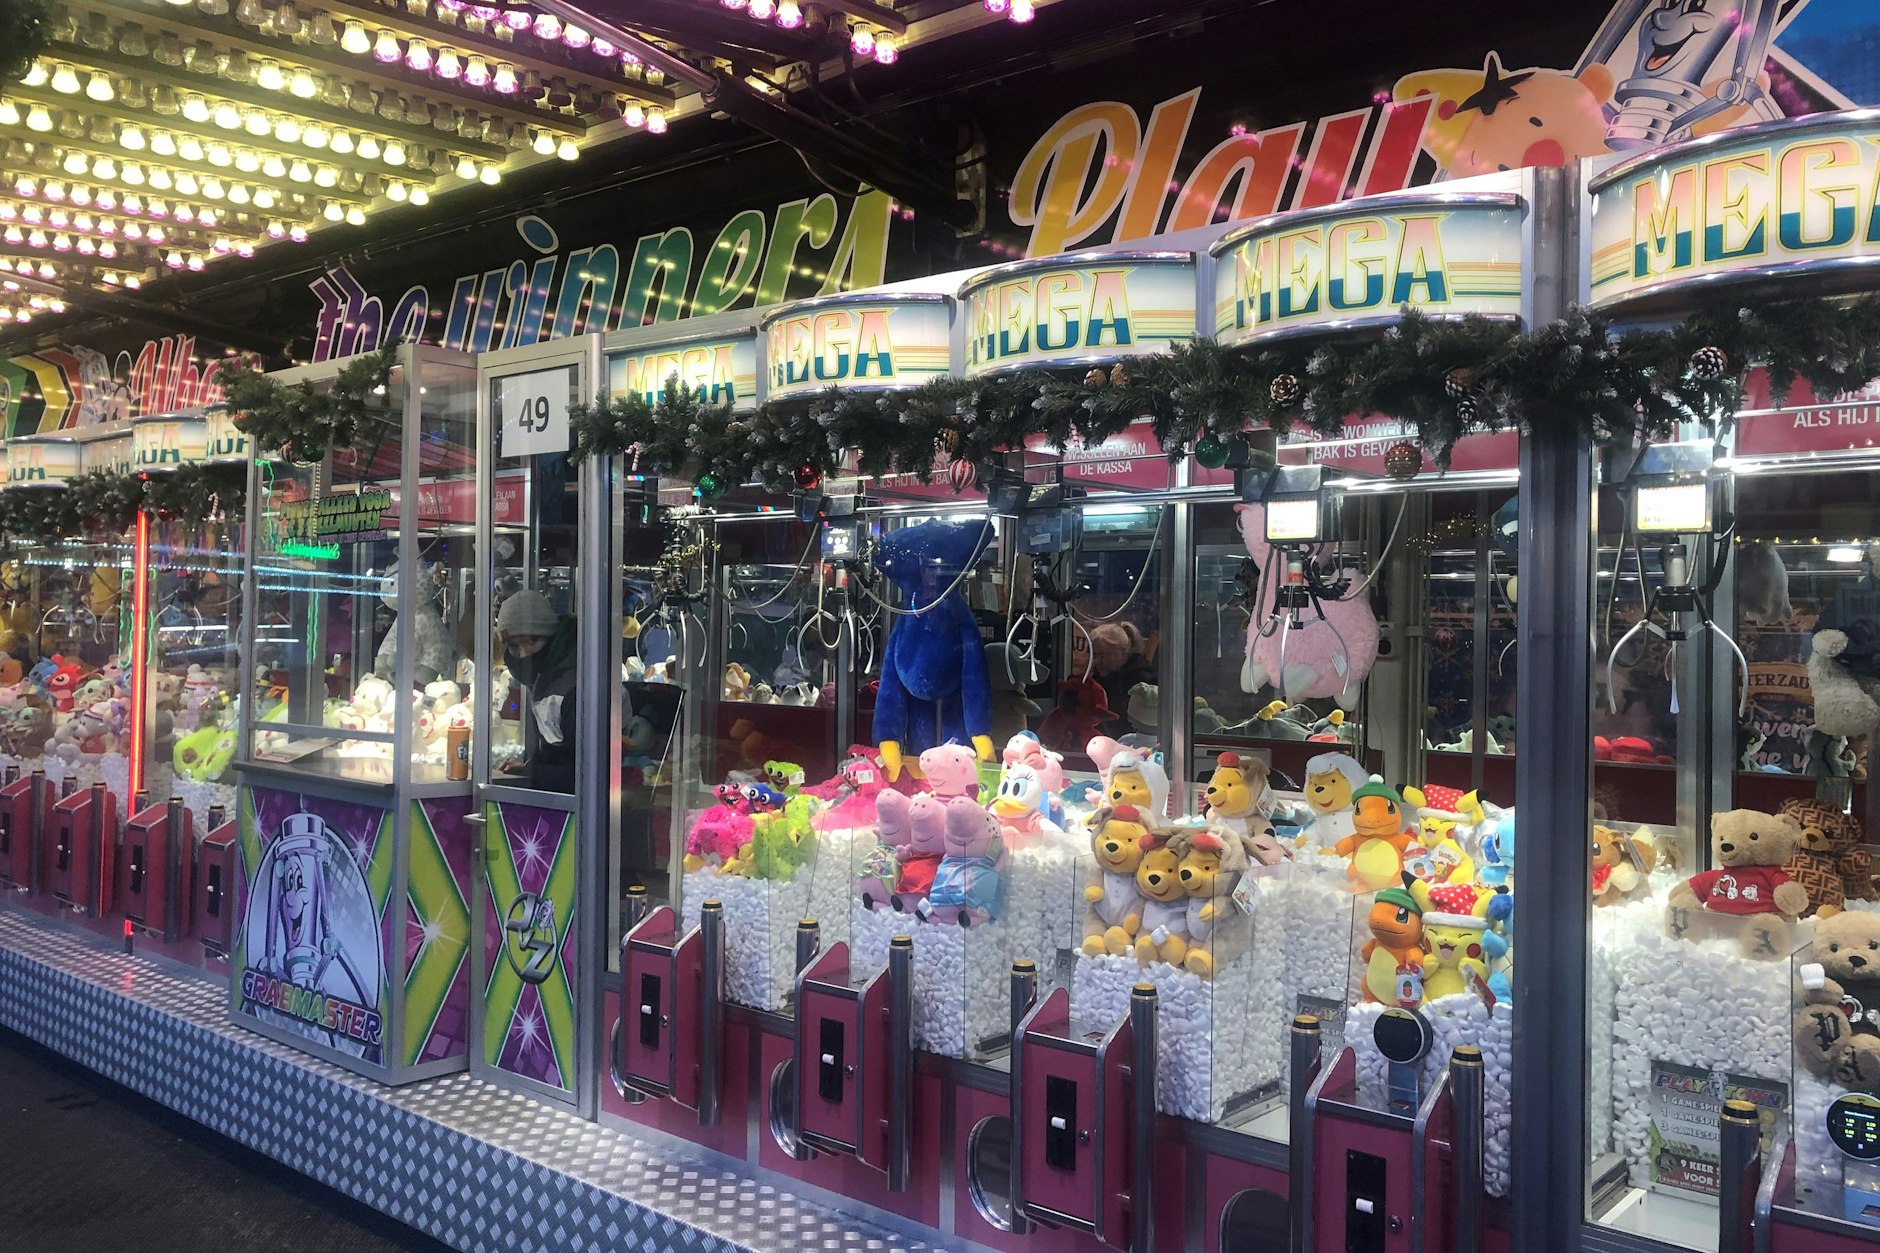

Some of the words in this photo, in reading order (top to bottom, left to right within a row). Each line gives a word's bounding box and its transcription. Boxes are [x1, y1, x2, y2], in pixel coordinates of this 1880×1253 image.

[1632, 136, 1880, 280] MEG
[1234, 214, 1451, 331] MEGA
[971, 268, 1132, 366] MEGA
[767, 307, 898, 395] MEGA
[626, 343, 737, 408] MEGA
[518, 396, 550, 433] 49
[1793, 410, 1831, 428] ALS
[1838, 407, 1868, 425] HIJ
[1123, 442, 1146, 456] AAN
[1314, 444, 1339, 460] BAK
[1344, 441, 1357, 457] IS
[1080, 462, 1094, 475] DE
[1097, 461, 1132, 475] KASSA
[241, 970, 382, 1044] GRABMASTER
[1655, 1071, 1708, 1094] PLAY
[1662, 1094, 1668, 1103] 1
[1680, 1159, 1688, 1169] 9
[1689, 1160, 1714, 1174] KEER
[1683, 1171, 1714, 1187] VOOR
